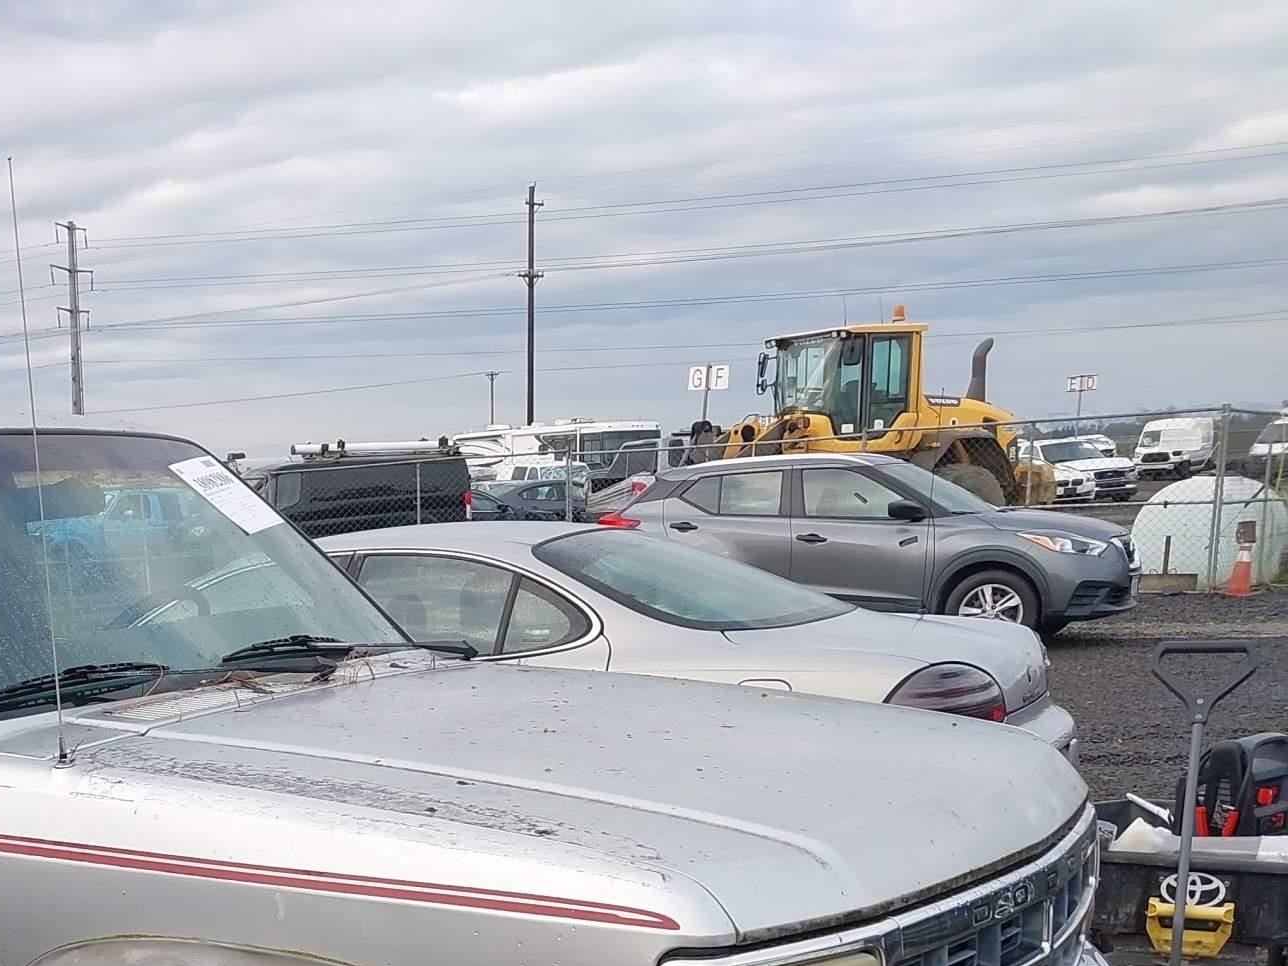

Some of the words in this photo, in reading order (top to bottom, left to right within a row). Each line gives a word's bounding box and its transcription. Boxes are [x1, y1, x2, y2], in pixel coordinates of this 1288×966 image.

[692, 368, 703, 389] G
[714, 367, 725, 388] F
[1069, 376, 1077, 391] E
[1086, 376, 1095, 389] D
